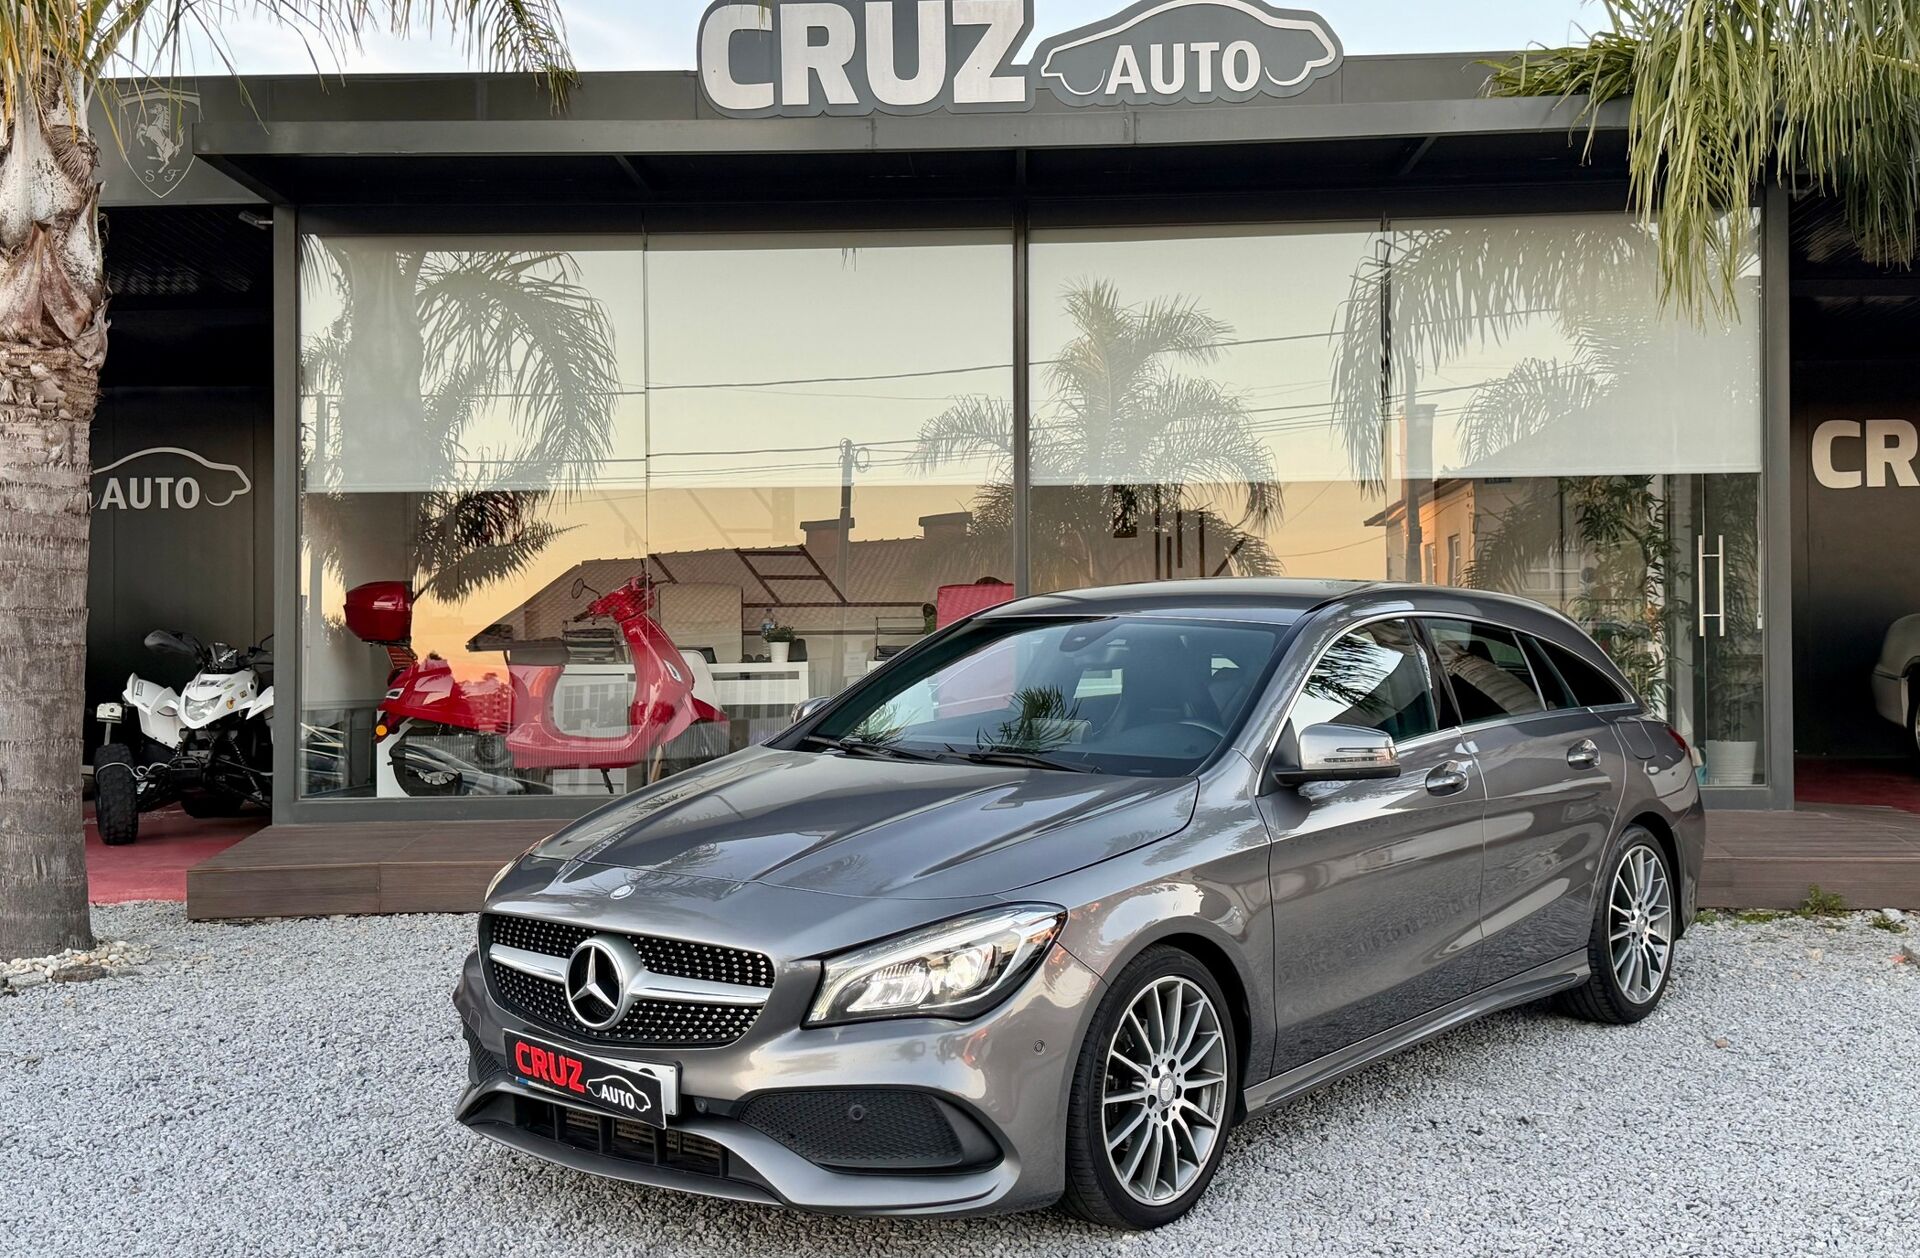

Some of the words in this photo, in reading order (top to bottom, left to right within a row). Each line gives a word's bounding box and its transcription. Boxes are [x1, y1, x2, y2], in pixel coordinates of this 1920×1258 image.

[701, 0, 1026, 110] CRUZ
[1104, 40, 1261, 95] AUTO
[144, 169, 155, 182] S
[1811, 419, 1920, 489] CR
[100, 476, 201, 510] AUTO
[515, 1041, 586, 1094] CRUZ
[601, 1083, 635, 1110] AUTO
